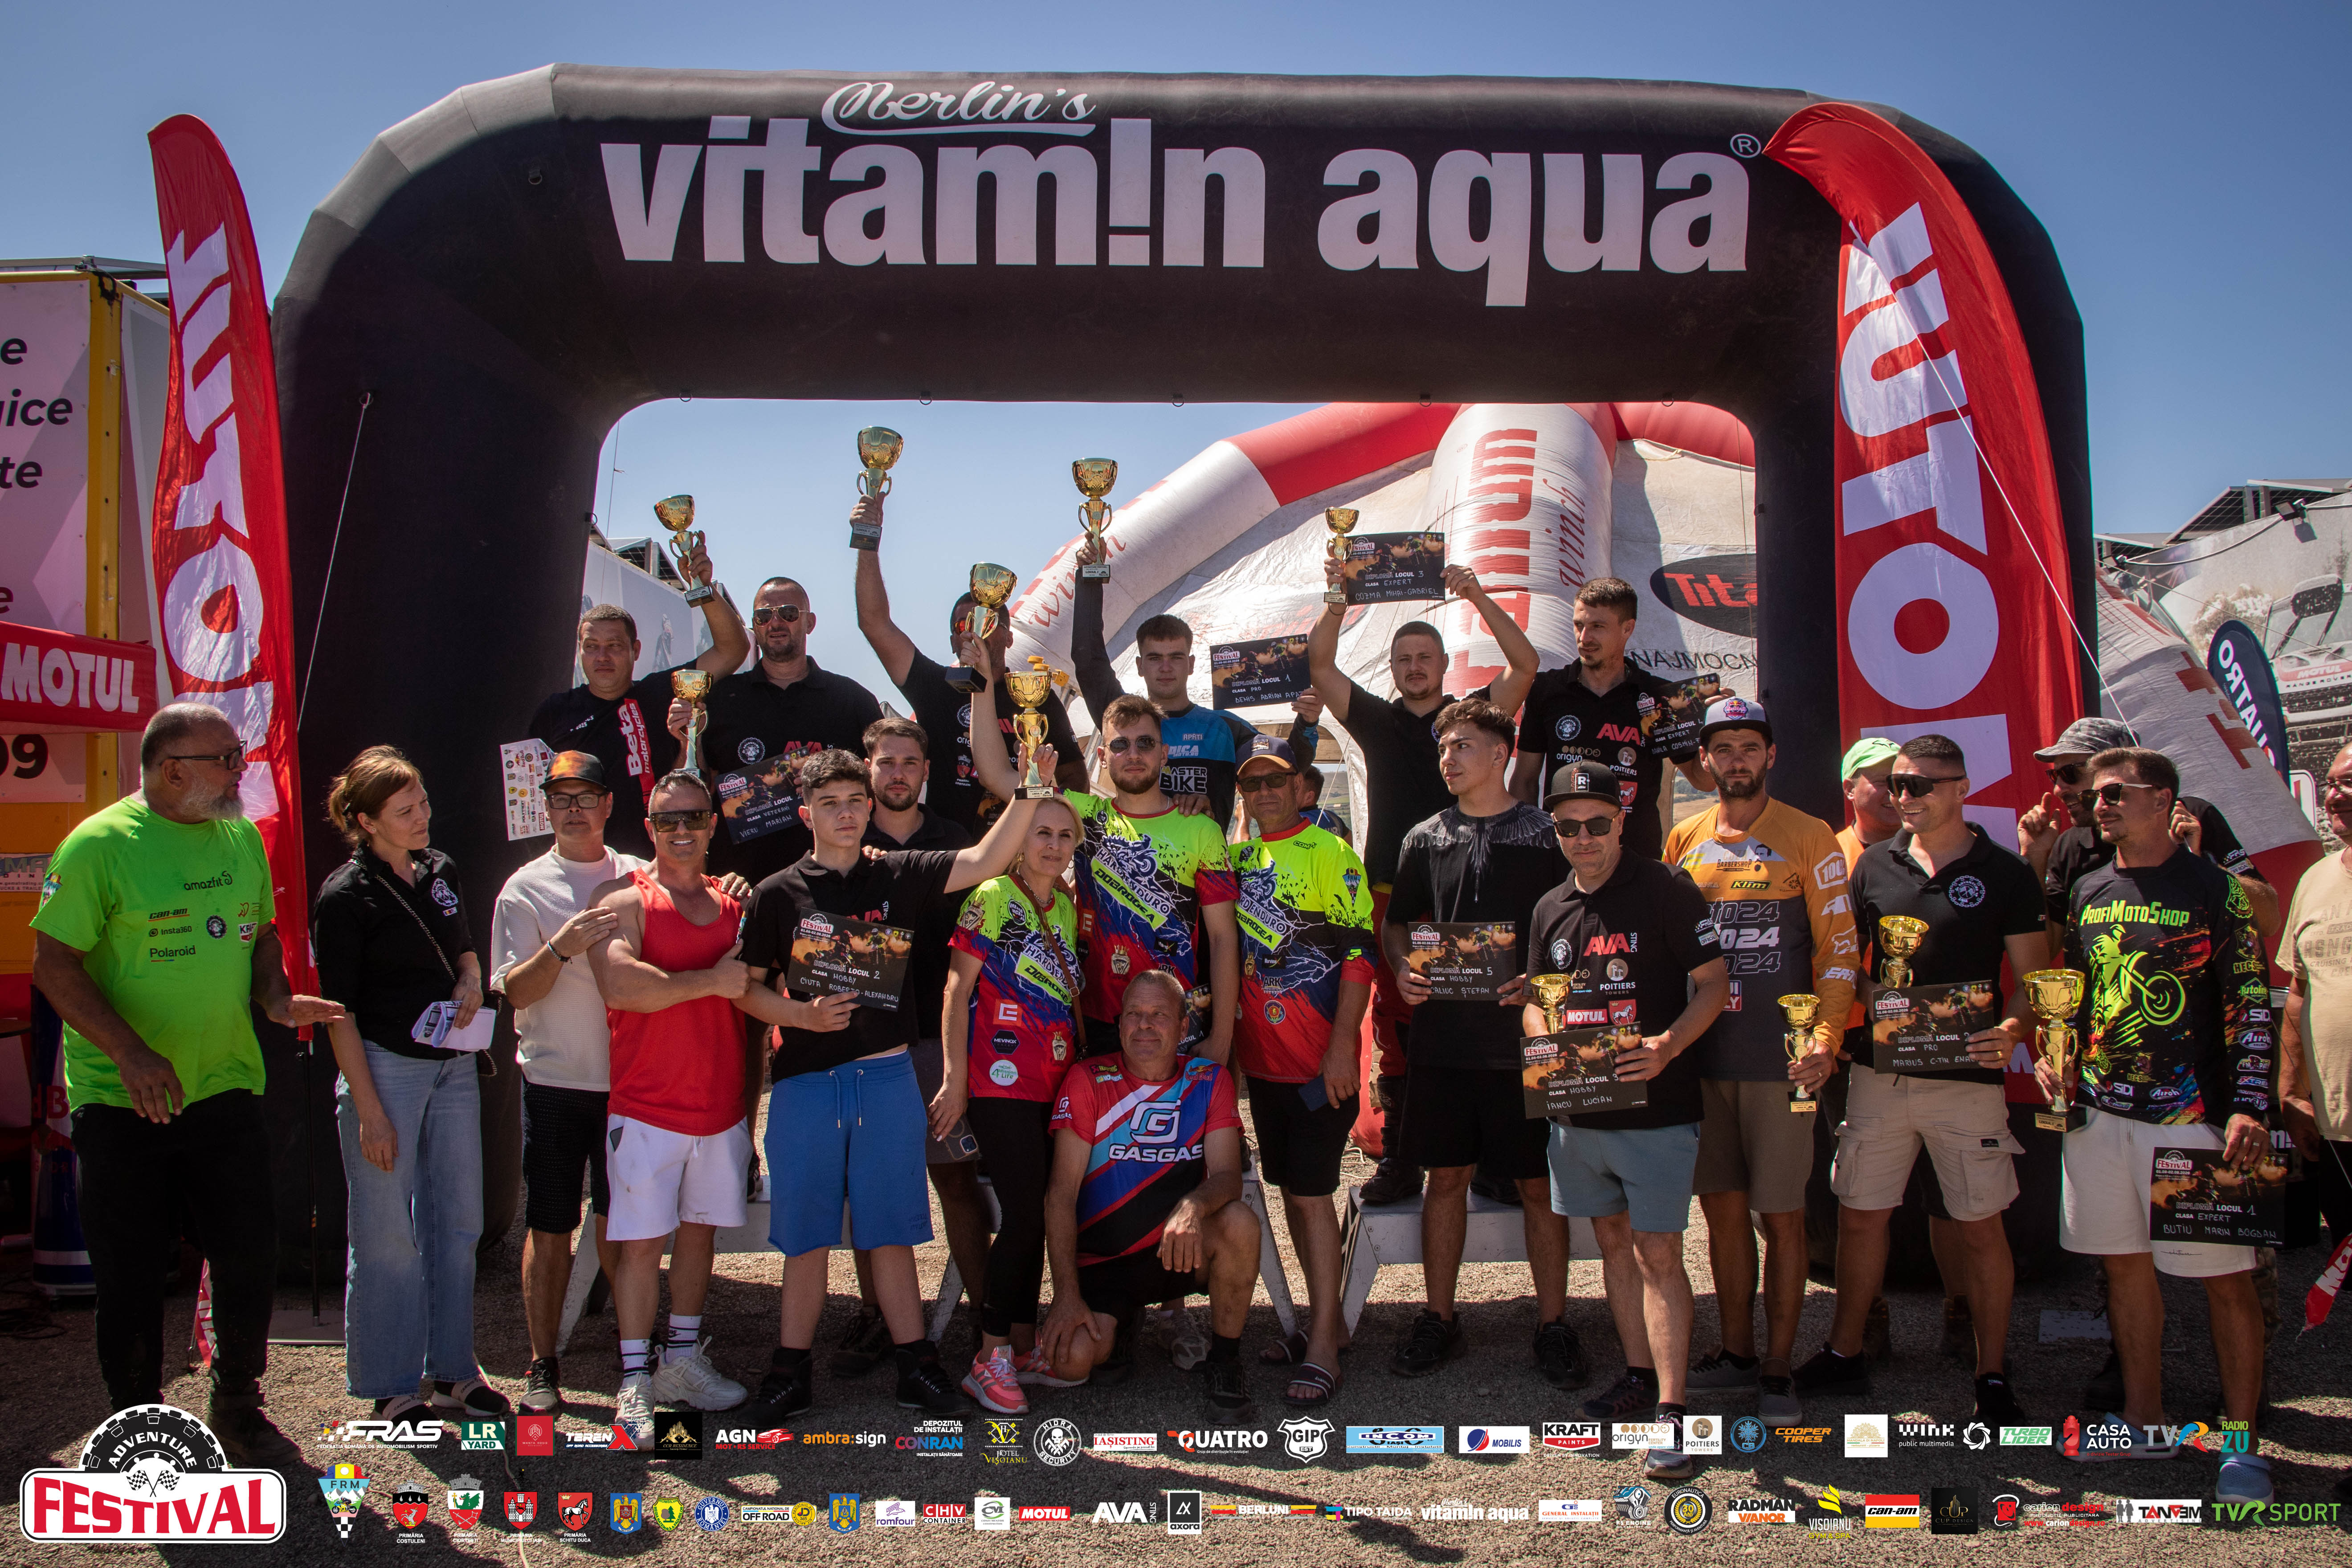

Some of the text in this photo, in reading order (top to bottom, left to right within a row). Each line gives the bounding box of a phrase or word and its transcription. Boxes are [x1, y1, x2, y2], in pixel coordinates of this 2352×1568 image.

[821, 81, 1096, 131] Merlin's
[600, 115, 1750, 306] vitam!n aqua
[1214, 652, 1239, 660] FESTIVAL
[2297, 665, 2341, 678] MOTUL
[1, 642, 139, 713] MOTUL
[1678, 720, 1696, 729] LOCUL
[1597, 723, 1641, 745] AVA
[1668, 730, 1690, 739] EXPERT
[618, 704, 643, 776] Beta
[1556, 753, 1583, 763] origyn
[1161, 766, 1207, 776] MASTER
[1610, 765, 1637, 776] POITIERS
[720, 778, 746, 791] FESTIVAL
[1160, 773, 1207, 794] BIKE
[774, 796, 793, 806] LOCUL
[184, 877, 223, 891] amazfit
[149, 908, 188, 919] can-am
[161, 926, 192, 935] Insta360
[802, 919, 832, 933] FESTIVAL
[1583, 933, 1631, 956] AVA
[150, 945, 196, 957] Polaroid
[848, 968, 870, 977] LOCUL
[874, 971, 880, 979] 2
[1486, 967, 1493, 976] 5
[833, 973, 856, 985] HOBBY
[1262, 976, 1282, 989] ARK
[1450, 975, 1473, 983] HOBBY
[1600, 982, 1636, 991] POITIERS
[1877, 999, 1908, 1009] FESTIVAL
[1567, 1011, 1605, 1023] MOTUL
[1525, 1045, 1556, 1055] FESTIVAL
[1893, 1059, 1923, 1067] MARIUS
[1585, 1076, 1609, 1084] LOCUL
[1613, 1073, 1619, 1081] 3
[1570, 1086, 1596, 1094] HOBBY
[2152, 1086, 2180, 1098] Airoh
[1547, 1095, 1613, 1110] IANCU LUCIAN
[1109, 1143, 1203, 1163] GASGAS
[2157, 1159, 2190, 1169] FESTIVAL
[2247, 1205, 2256, 1215] 1
[2197, 1213, 2231, 1222] EXPERT
[2238, 1228, 2277, 1239] BOGDAN
